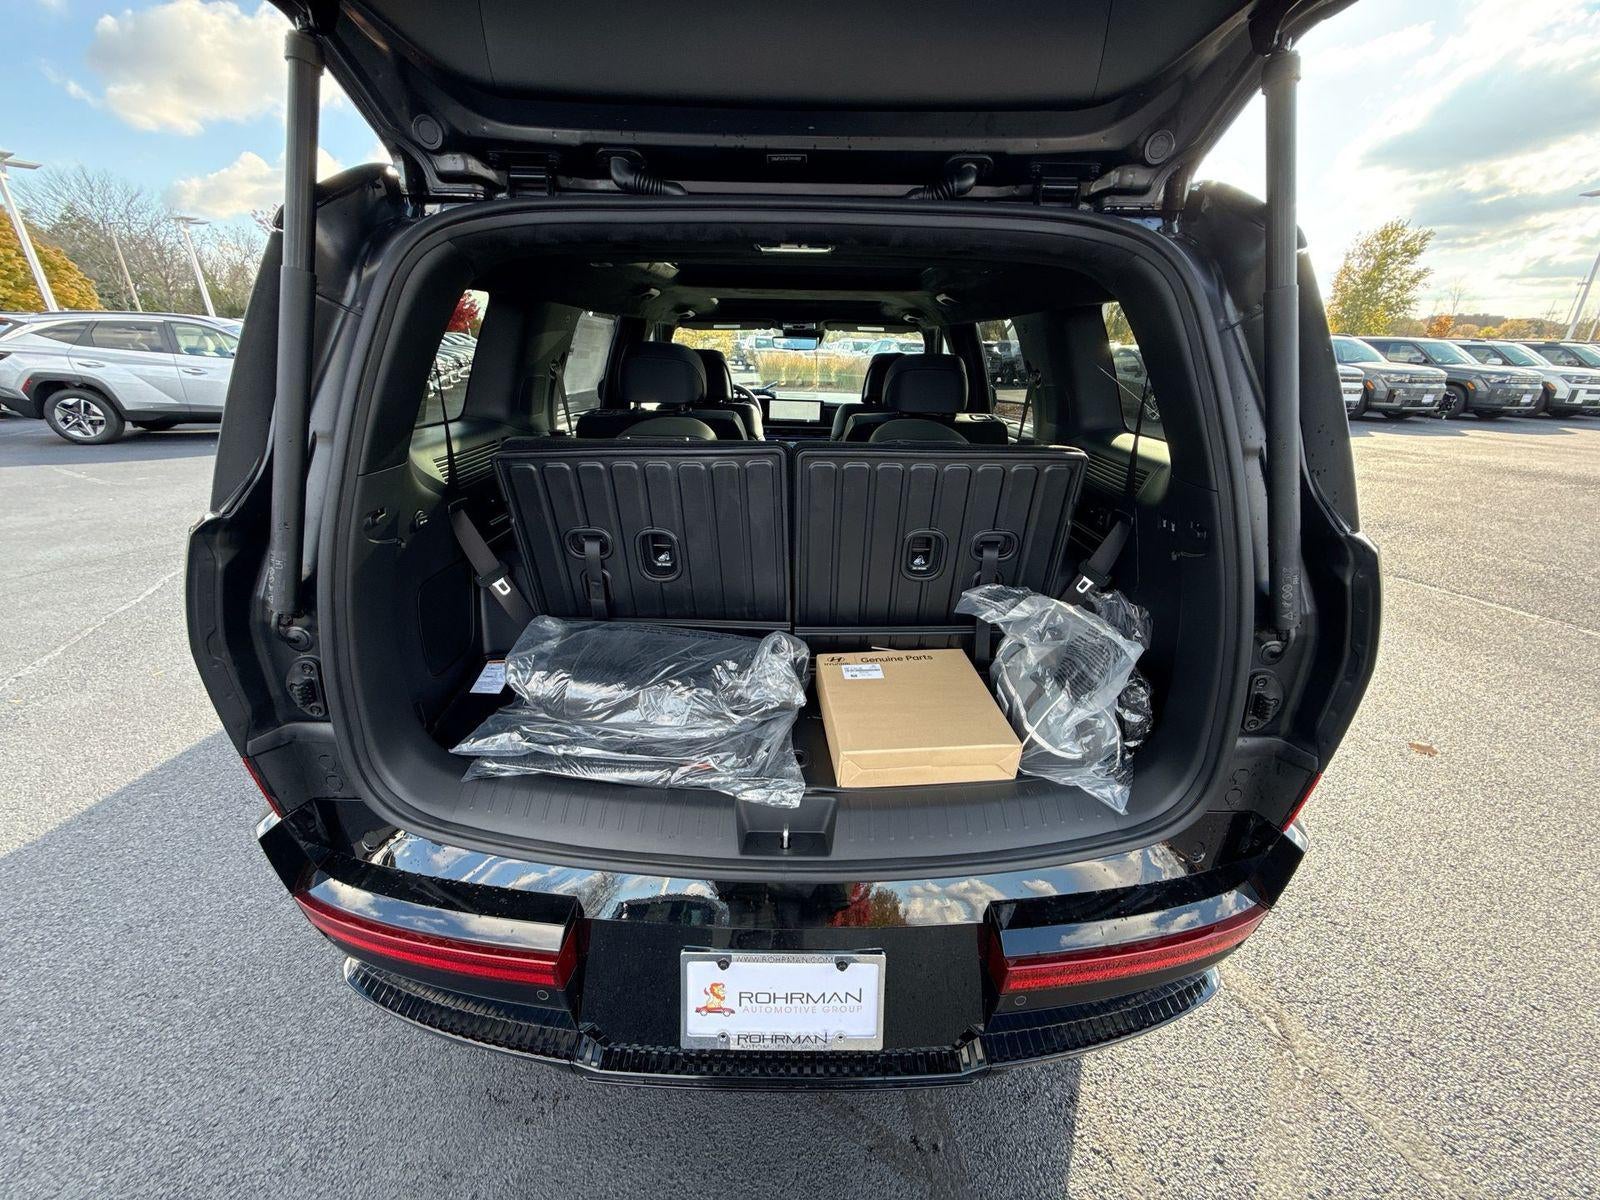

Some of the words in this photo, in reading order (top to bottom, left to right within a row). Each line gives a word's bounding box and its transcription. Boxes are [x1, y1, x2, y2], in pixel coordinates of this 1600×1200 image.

[860, 655, 903, 663] Genuine
[736, 955, 834, 963] WWW.ROHRMAN.COM
[738, 987, 863, 1007] ROHRMAN
[742, 1005, 817, 1014] AUTOMOTIVE
[822, 1005, 863, 1014] GROUP
[737, 1031, 828, 1046] ROHRMAN
